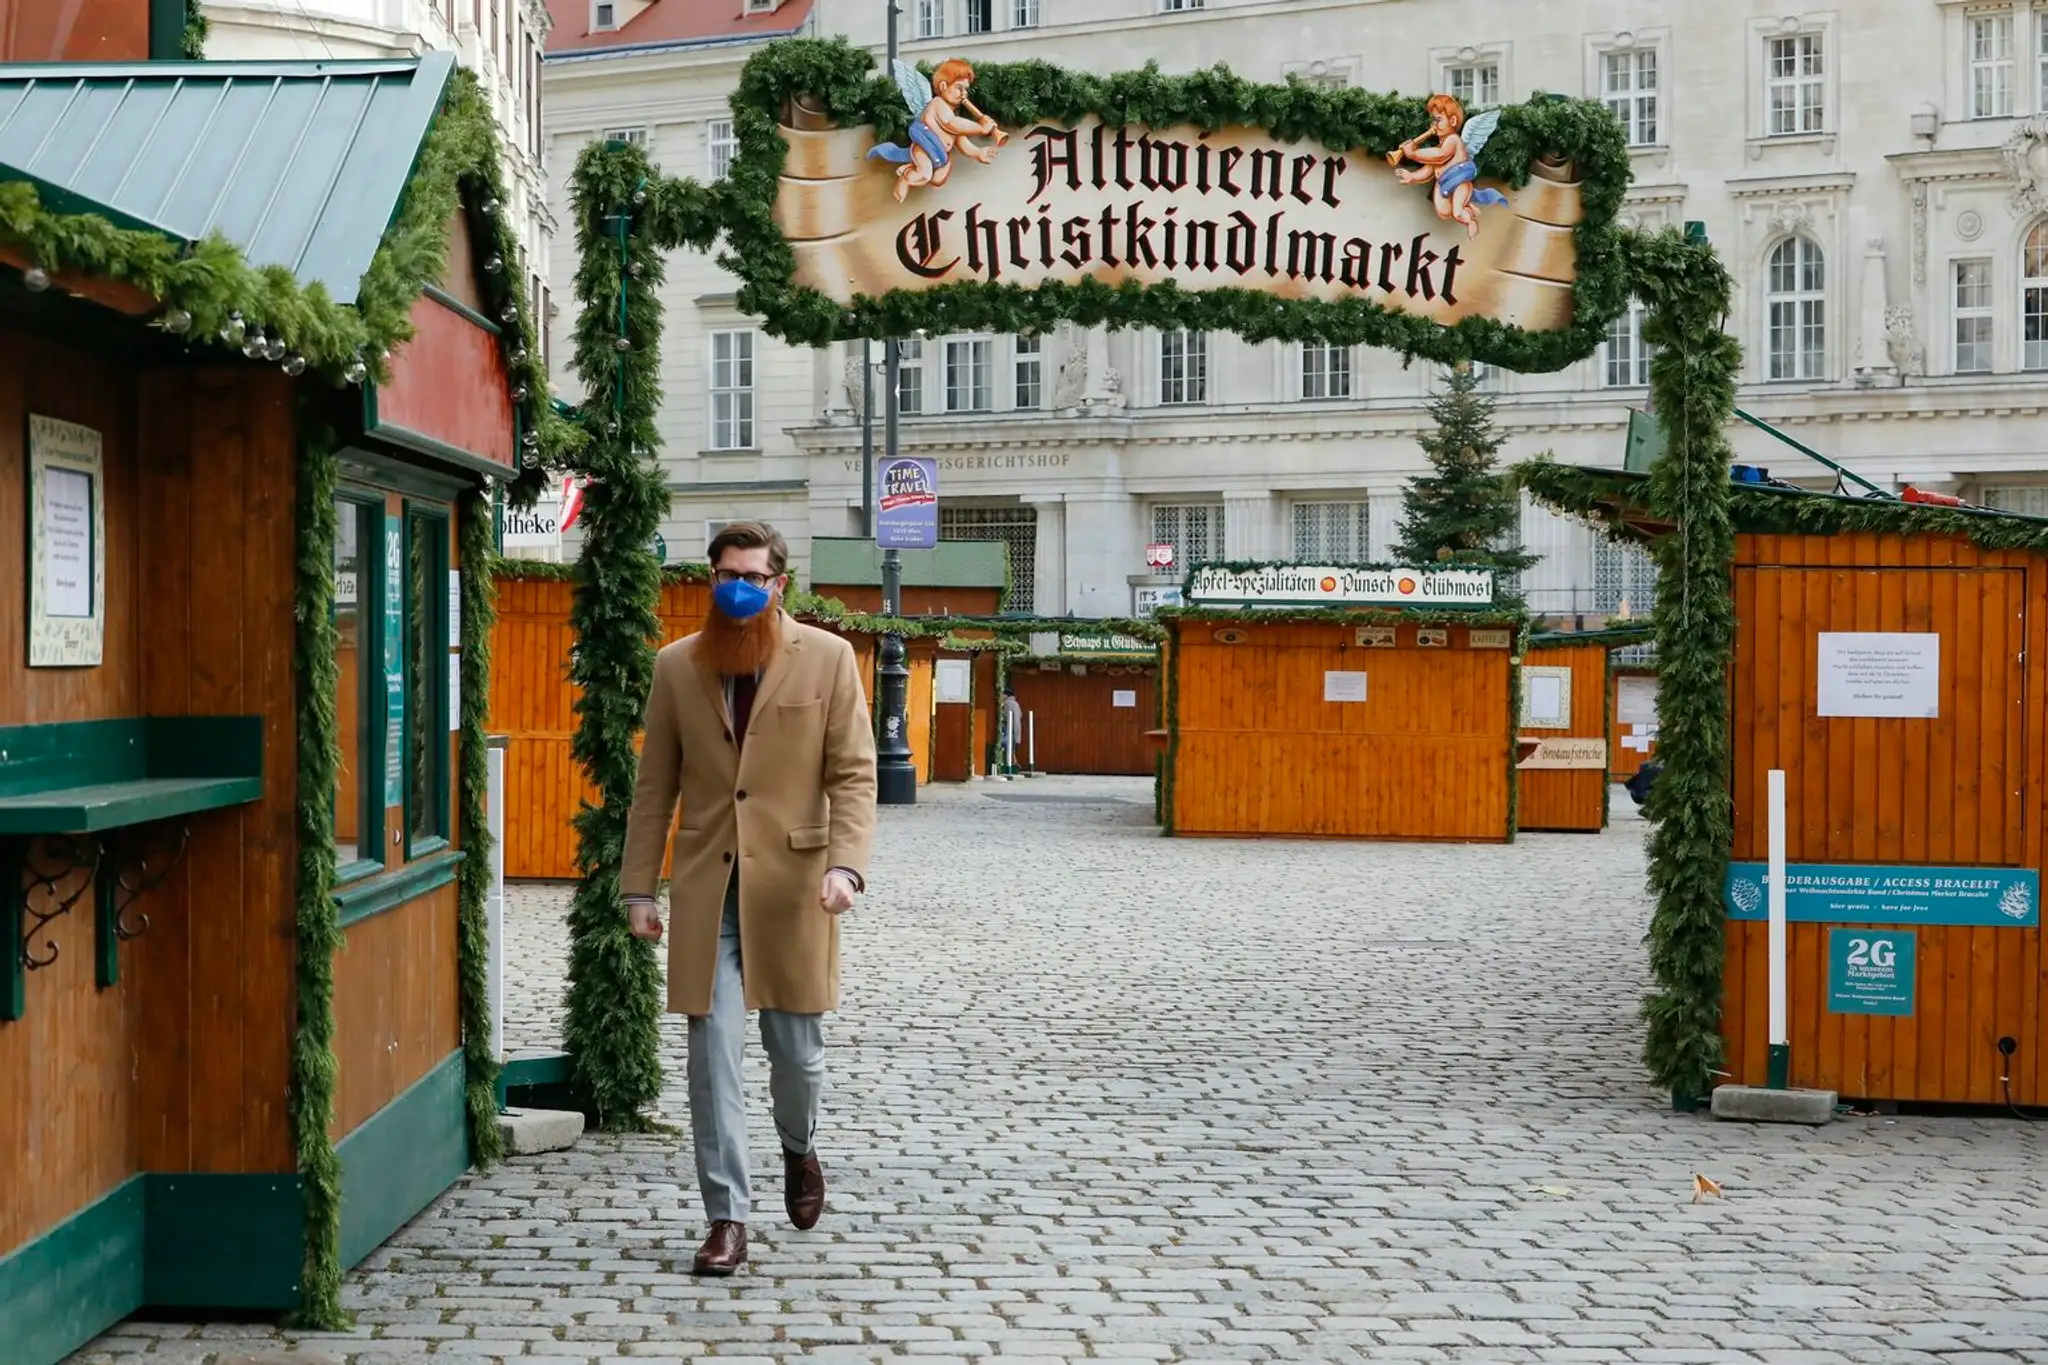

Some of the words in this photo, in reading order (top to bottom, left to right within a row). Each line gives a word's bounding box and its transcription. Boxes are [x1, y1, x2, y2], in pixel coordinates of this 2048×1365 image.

[1026, 123, 1346, 210] Altwiener
[895, 202, 1466, 306] Christkindlmarkt
[844, 454, 1070, 472] VEGSGERICHTSHOF
[883, 479, 929, 496] TRAVEL
[501, 513, 556, 535] otheke
[1341, 573, 1394, 597] Punsch
[1422, 576, 1491, 597] Glühmost
[1138, 602, 1158, 614] LIK
[1063, 634, 1102, 651] Schnaps
[1542, 743, 1603, 766] Brotaufstriche
[1761, 874, 1870, 888] BDERAUSGABE
[1883, 877, 1931, 888] ACCESS
[1934, 878, 2001, 890] BRACELET
[1846, 938, 1897, 967] 2G
